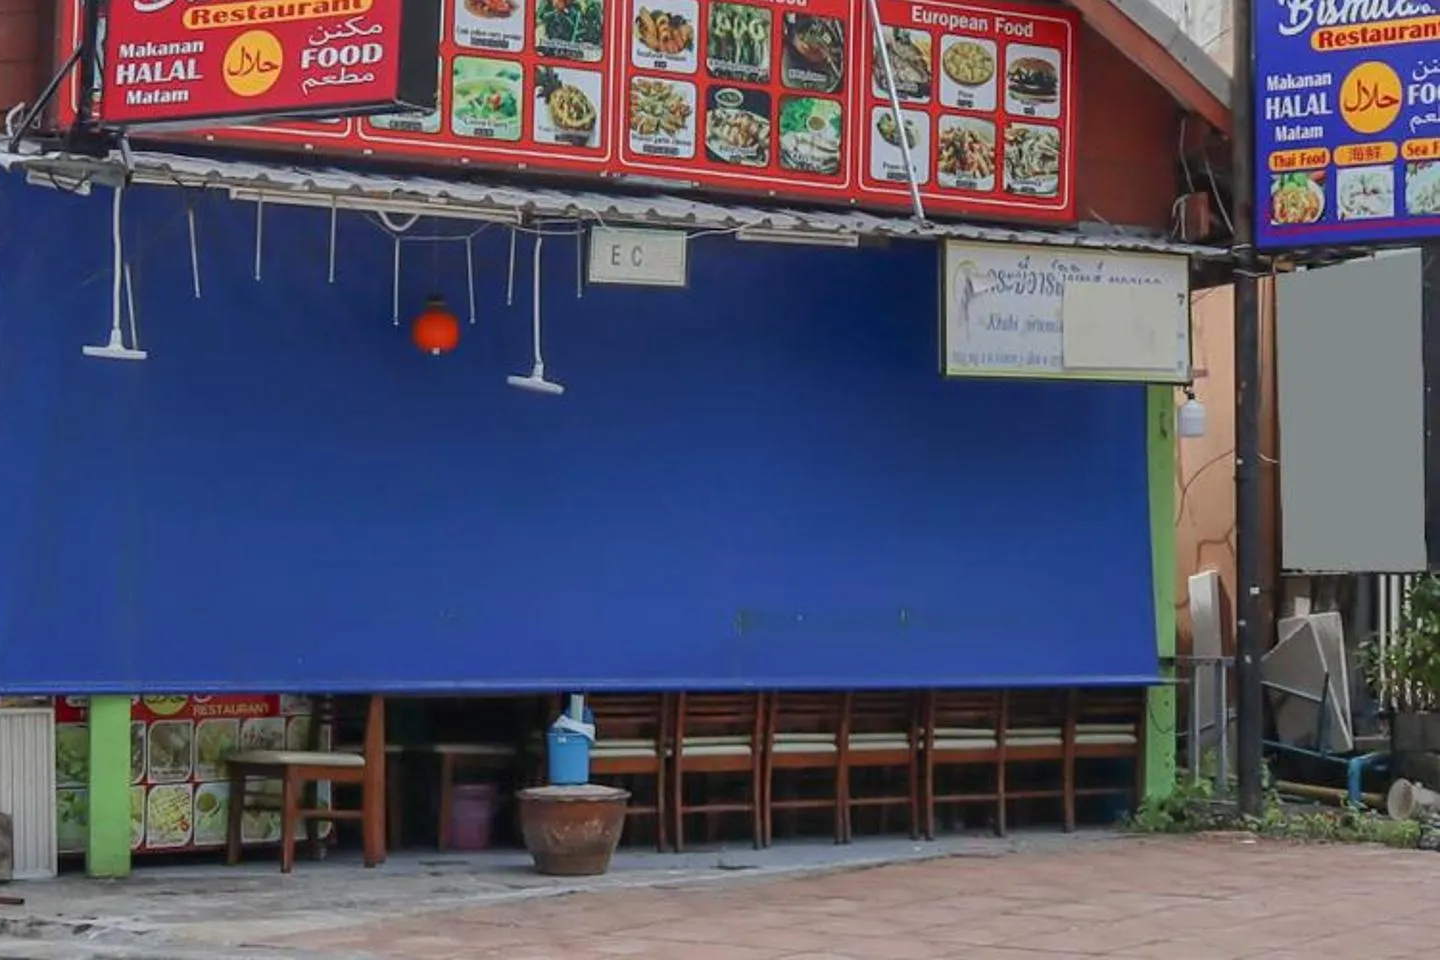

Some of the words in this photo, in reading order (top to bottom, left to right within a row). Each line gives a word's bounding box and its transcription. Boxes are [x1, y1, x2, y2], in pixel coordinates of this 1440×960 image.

[911, 6, 988, 33] European
[995, 17, 1034, 38] Food
[1318, 20, 1440, 49] Restauran
[119, 40, 205, 59] Makanan
[228, 46, 280, 77] حلال
[300, 43, 383, 70] FOOD
[116, 58, 204, 85] HALAL
[302, 68, 375, 97] مطعم
[1266, 72, 1332, 91] Makanan
[126, 88, 189, 106] Matam
[1265, 92, 1333, 120] HALAL
[1344, 79, 1400, 112] حلال
[1275, 125, 1324, 141] Matam
[1300, 151, 1326, 165] Food
[611, 246, 622, 267] E
[631, 246, 643, 268] C
